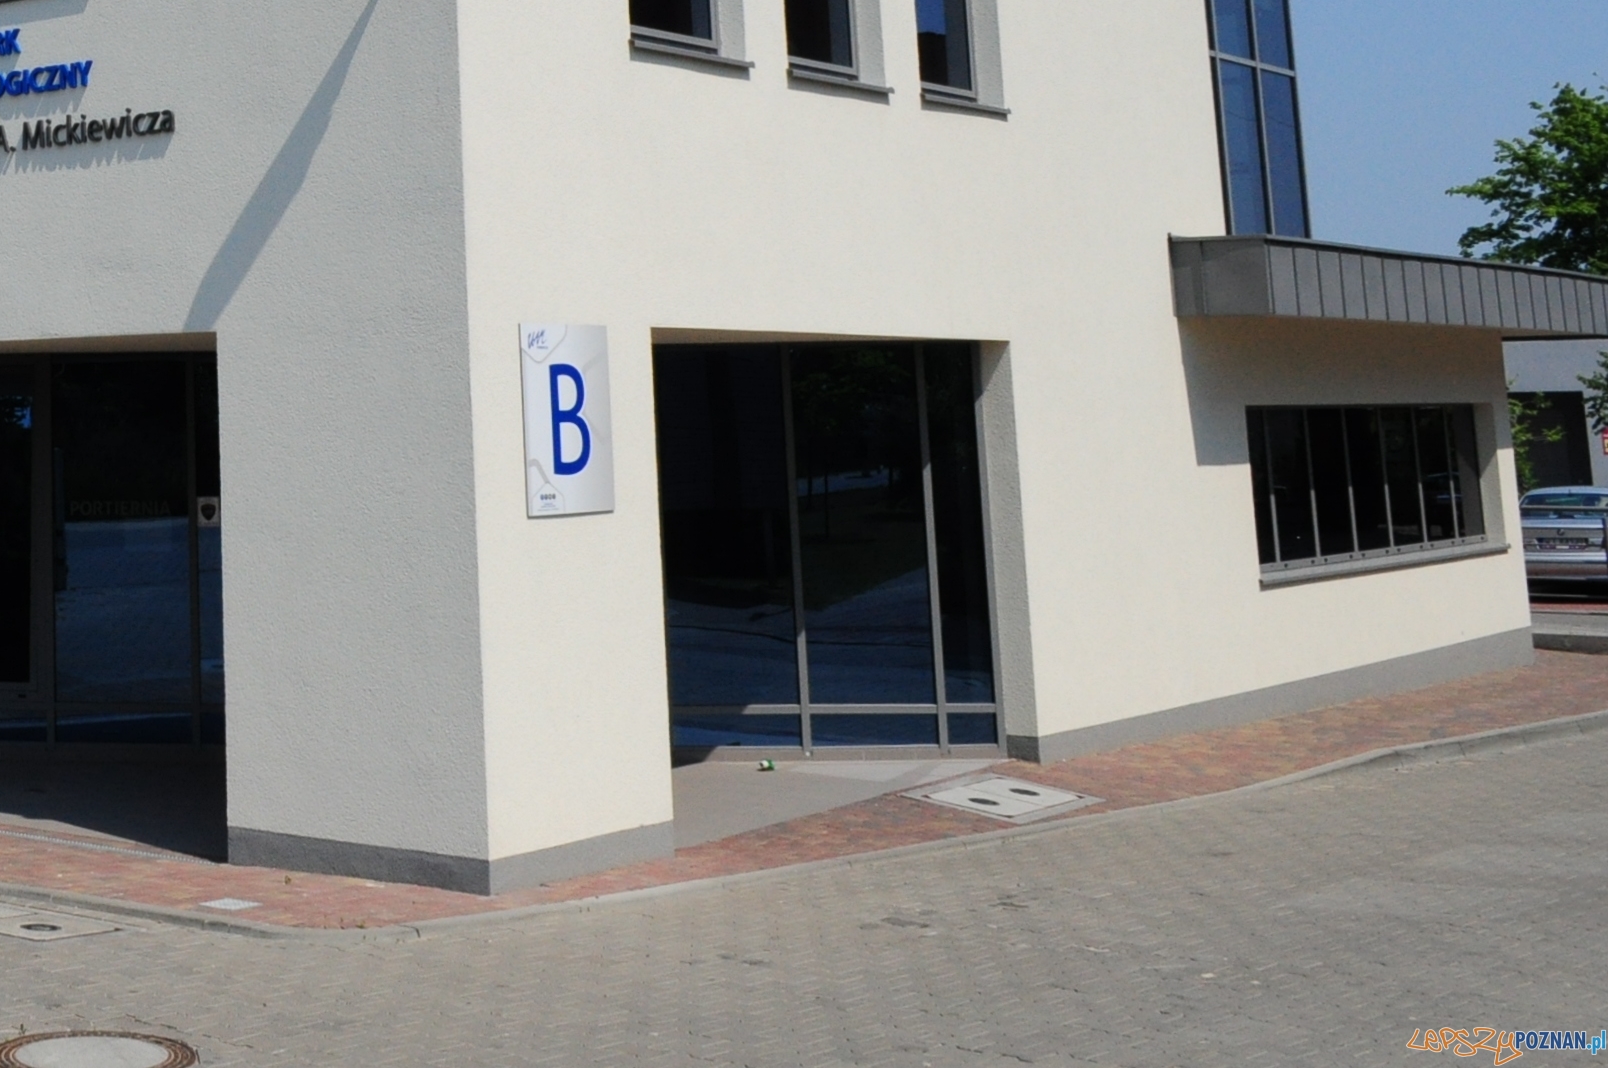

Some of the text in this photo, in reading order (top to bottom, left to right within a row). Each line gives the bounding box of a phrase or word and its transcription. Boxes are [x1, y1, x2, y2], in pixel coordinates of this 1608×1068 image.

[21, 107, 176, 151] Mickiewicza
[548, 363, 591, 476] B
[69, 499, 172, 517] PORTIERNIA
